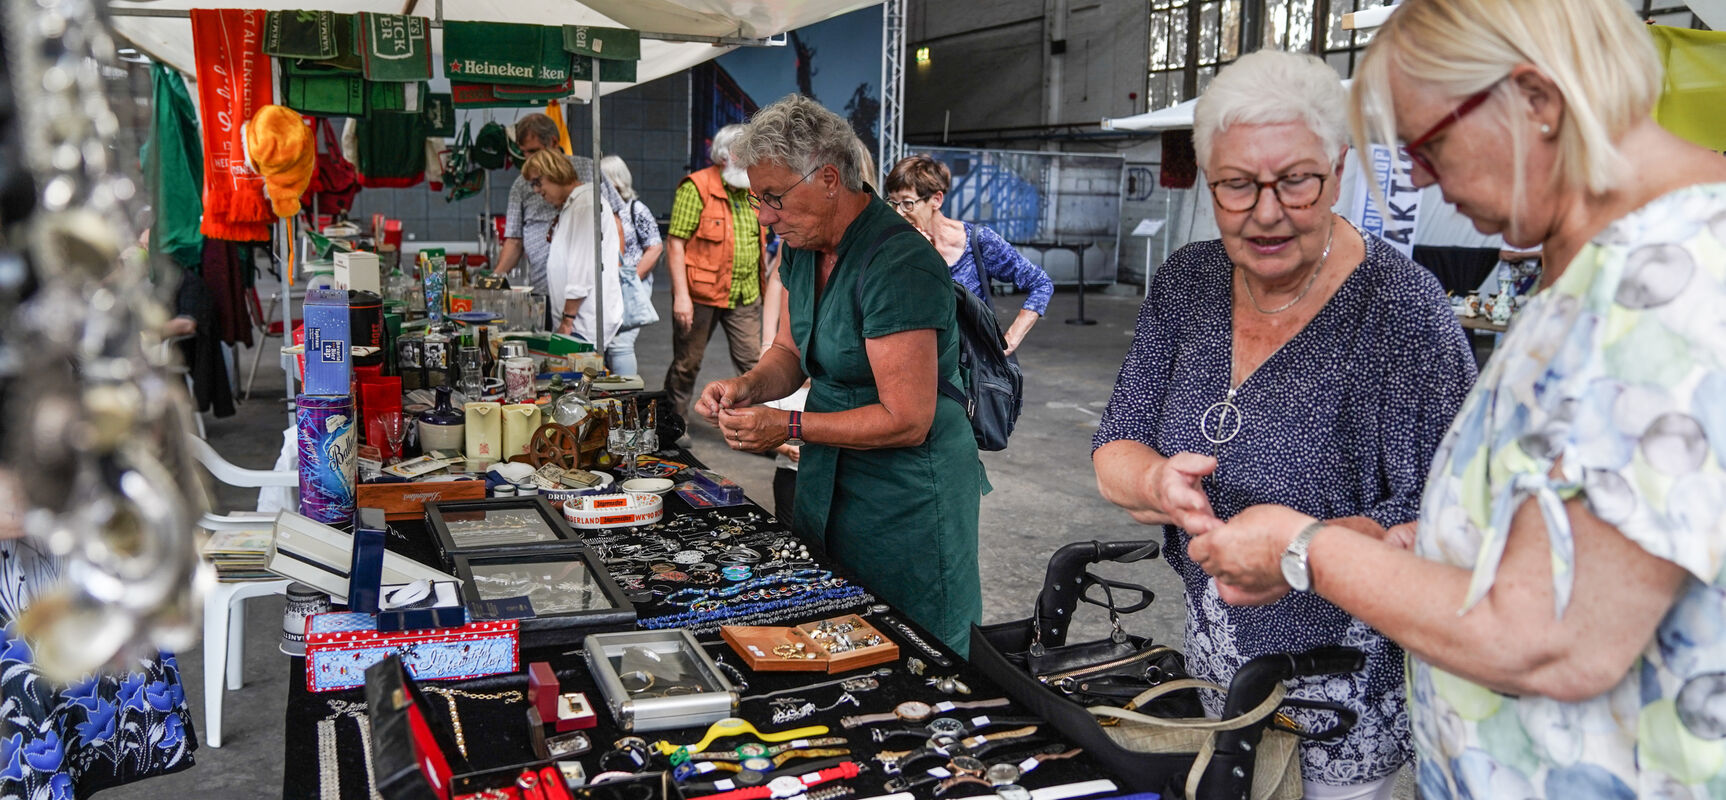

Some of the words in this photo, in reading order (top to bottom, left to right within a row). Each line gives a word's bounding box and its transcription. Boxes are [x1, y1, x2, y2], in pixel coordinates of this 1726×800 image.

[465, 60, 534, 78] Heineken
[324, 344, 332, 358] tap
[547, 493, 575, 501] DRUM
[564, 514, 600, 525] NEDERLAND
